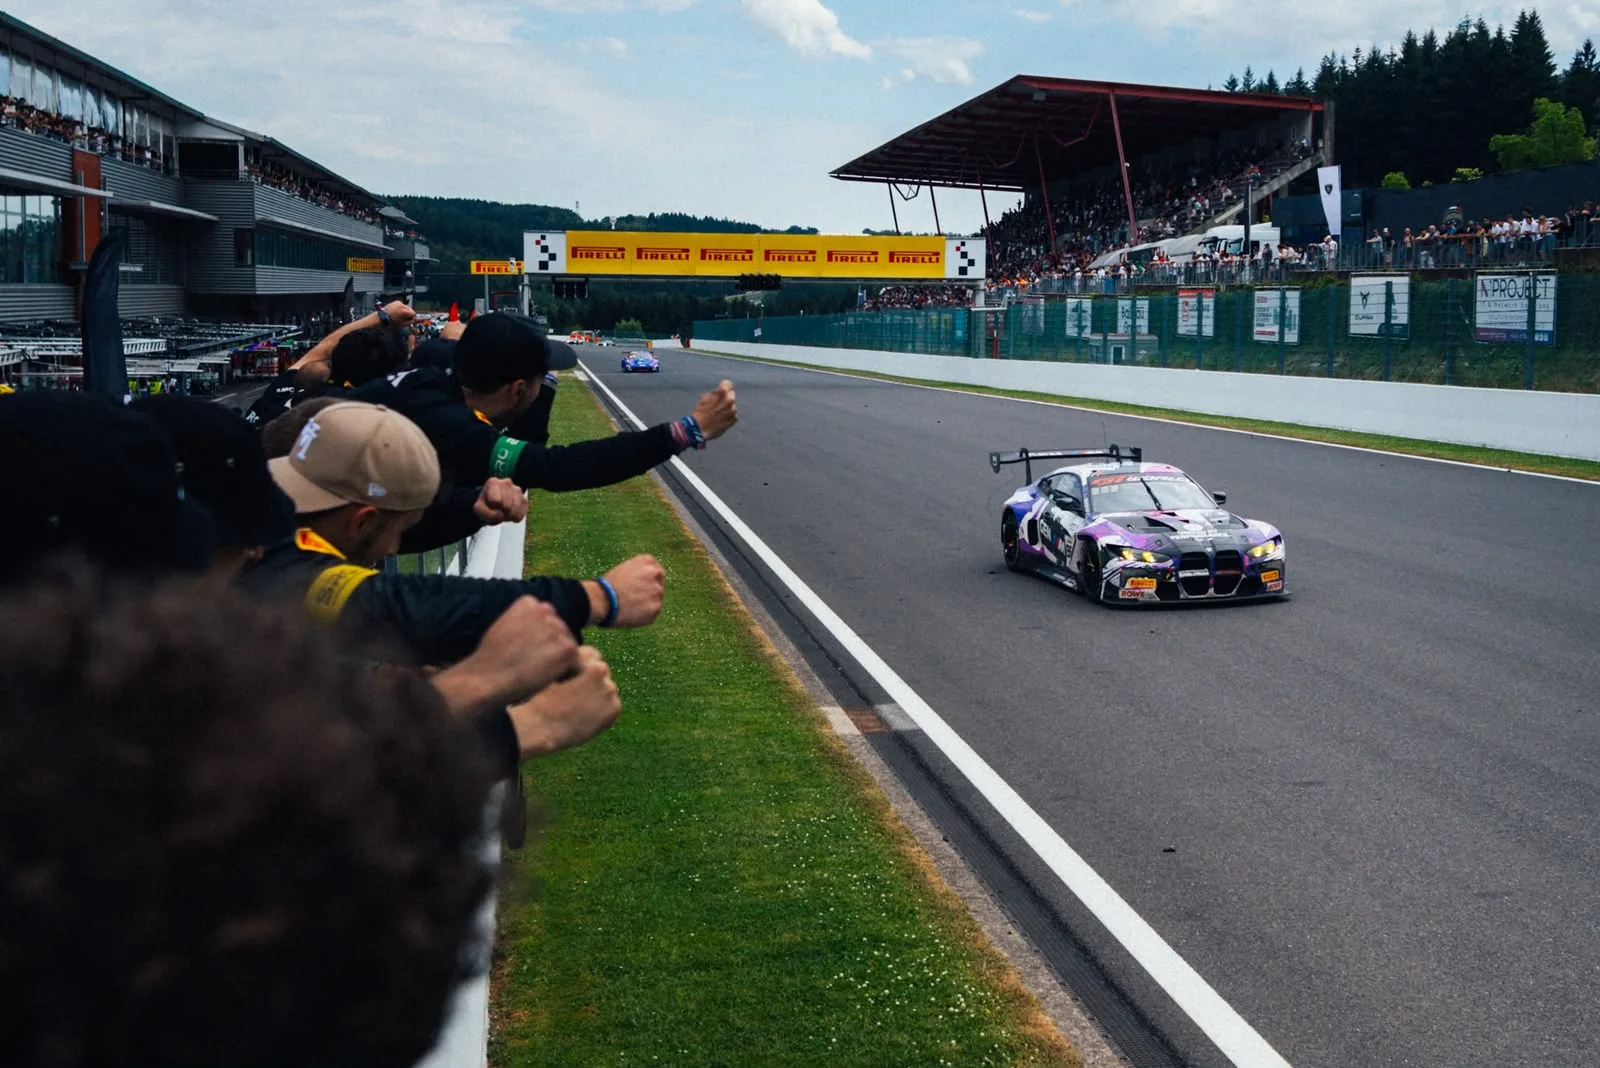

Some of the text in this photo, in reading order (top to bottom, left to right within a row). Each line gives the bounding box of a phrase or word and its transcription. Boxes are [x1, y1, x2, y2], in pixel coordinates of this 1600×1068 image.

[572, 246, 940, 263] PIRELLI PIRELLI PIRELLI PIRELLI PIRELLI PIRELLI
[476, 262, 522, 274] PIRELI
[1121, 590, 1146, 598] ROWE
